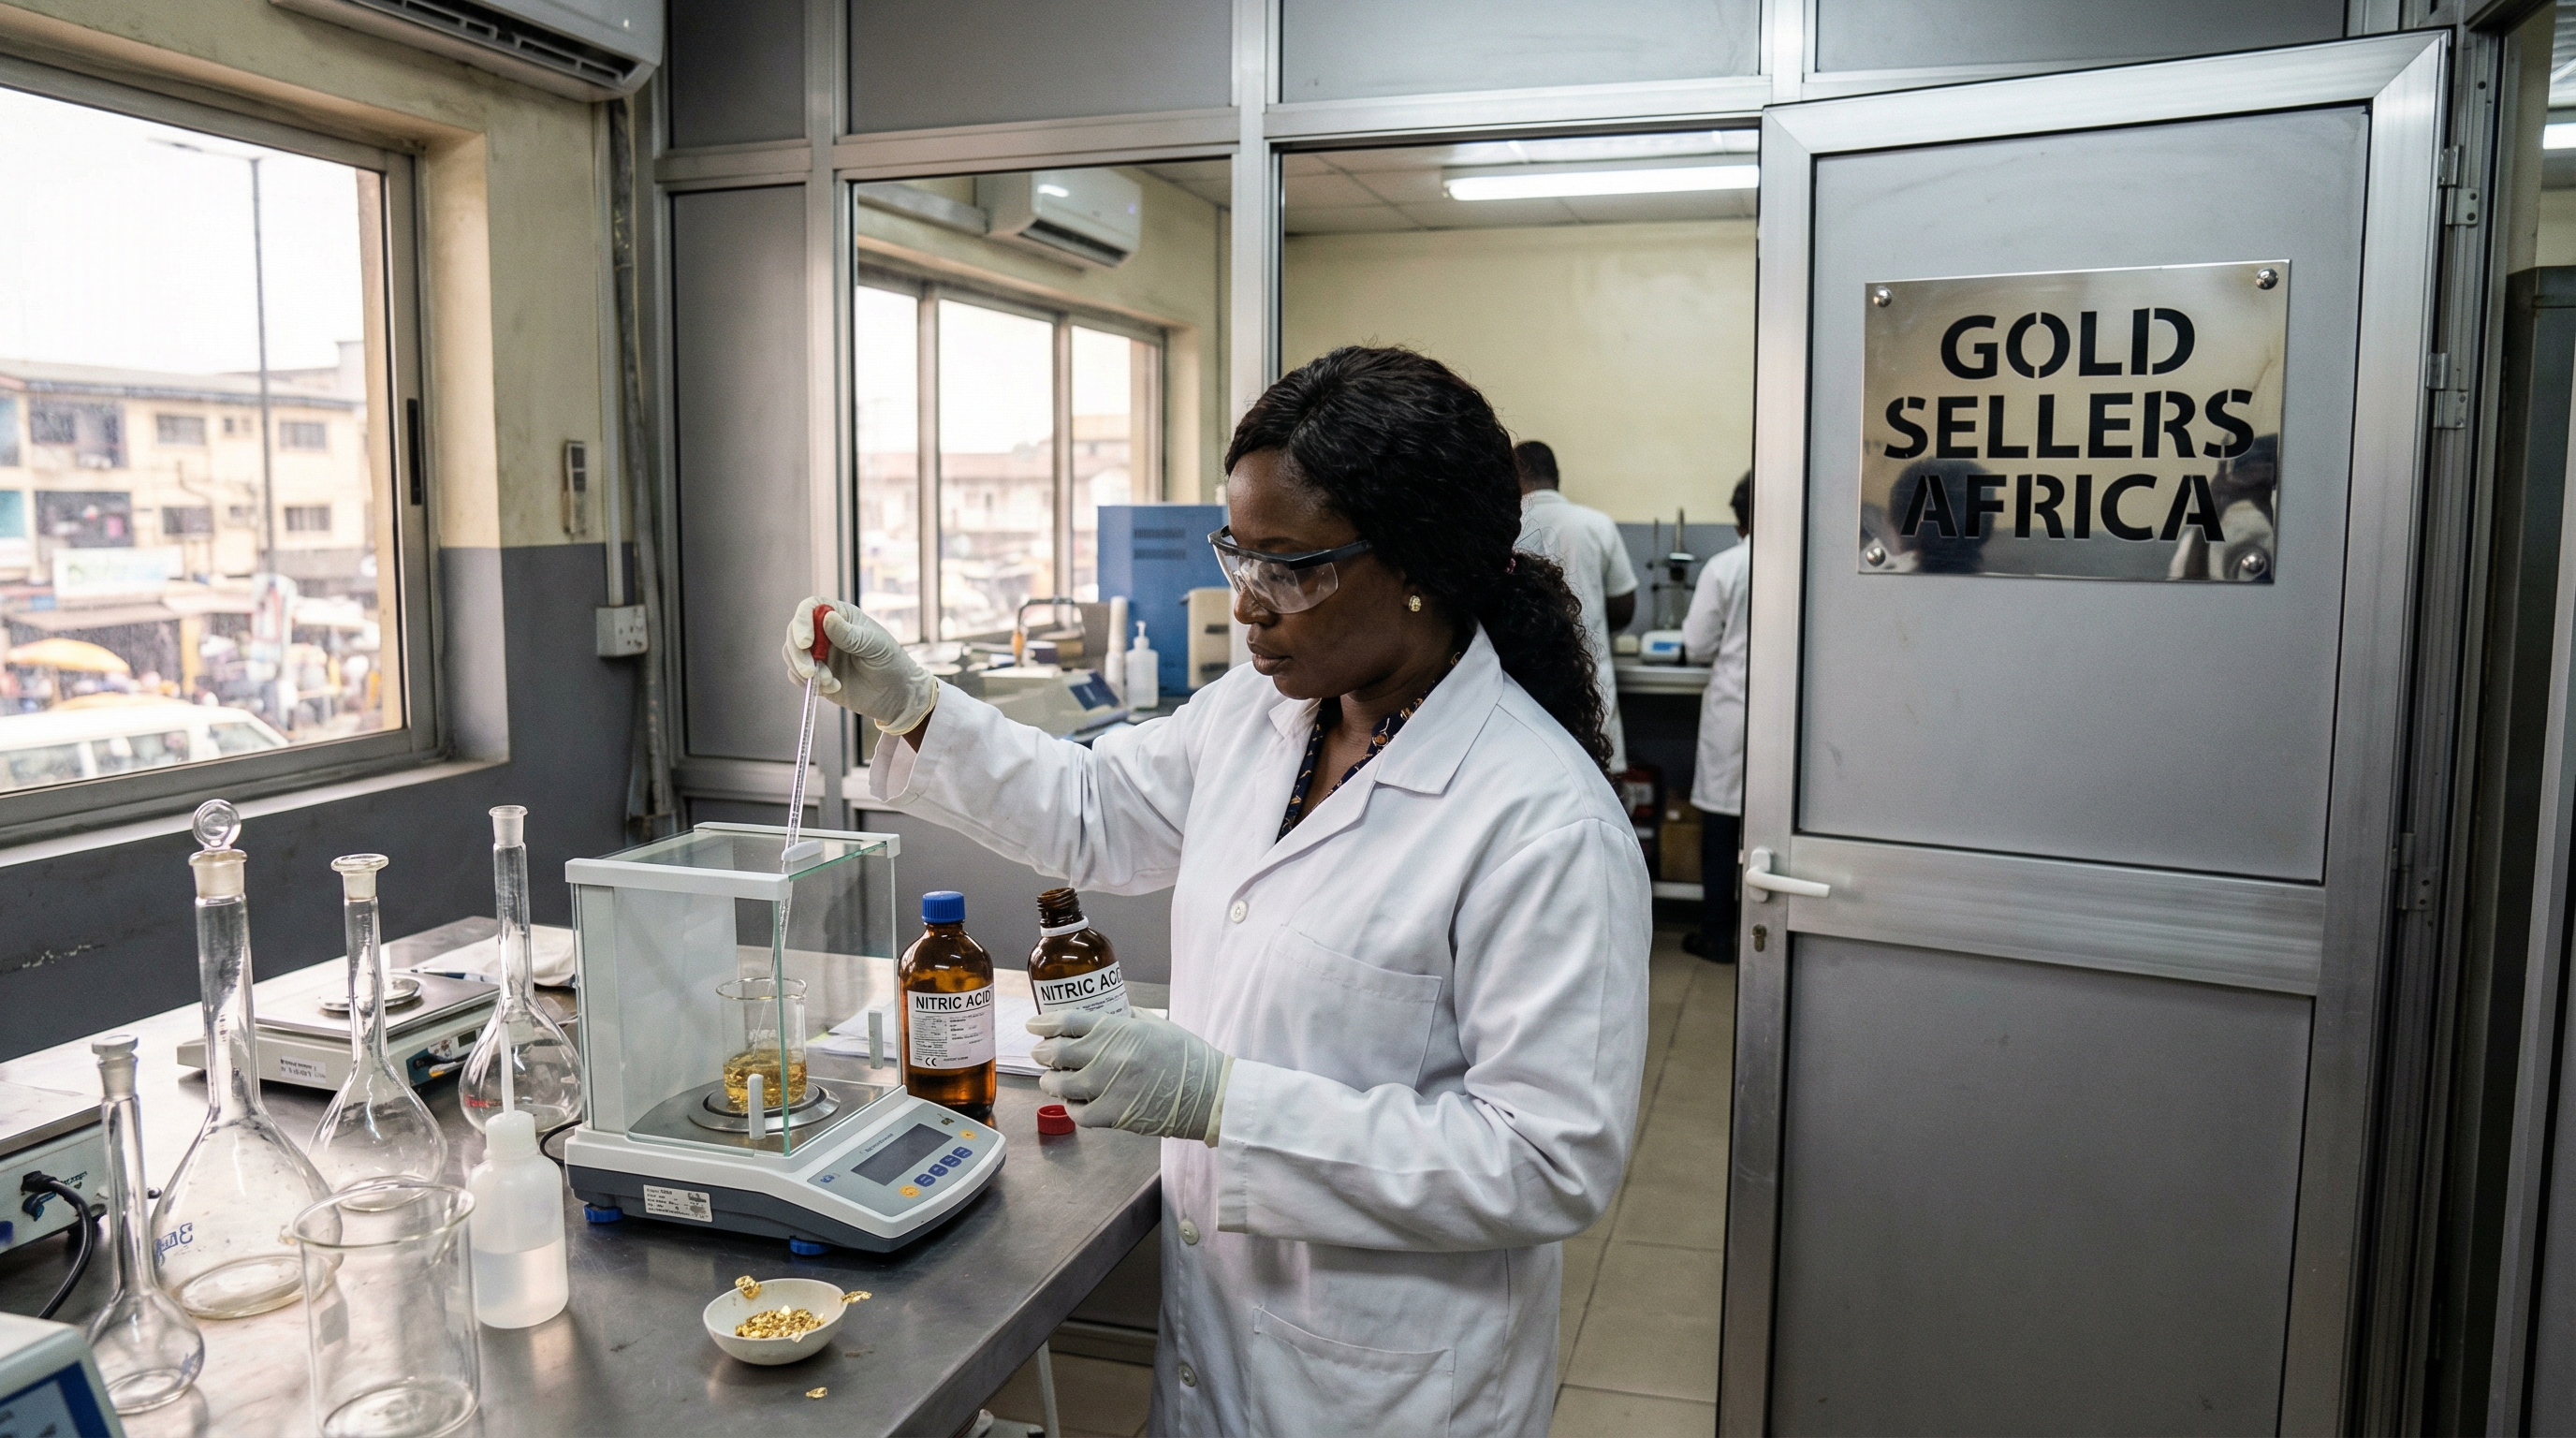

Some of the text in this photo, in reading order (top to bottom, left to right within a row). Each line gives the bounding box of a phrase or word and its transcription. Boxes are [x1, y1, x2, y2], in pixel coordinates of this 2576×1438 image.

[1940, 307, 2195, 380] GOLD
[1883, 389, 2255, 460] SELLERS
[1900, 473, 2226, 543] AFRICA
[915, 990, 991, 1010] NITRIC ACID
[1040, 977, 1095, 1002] NITRIC
